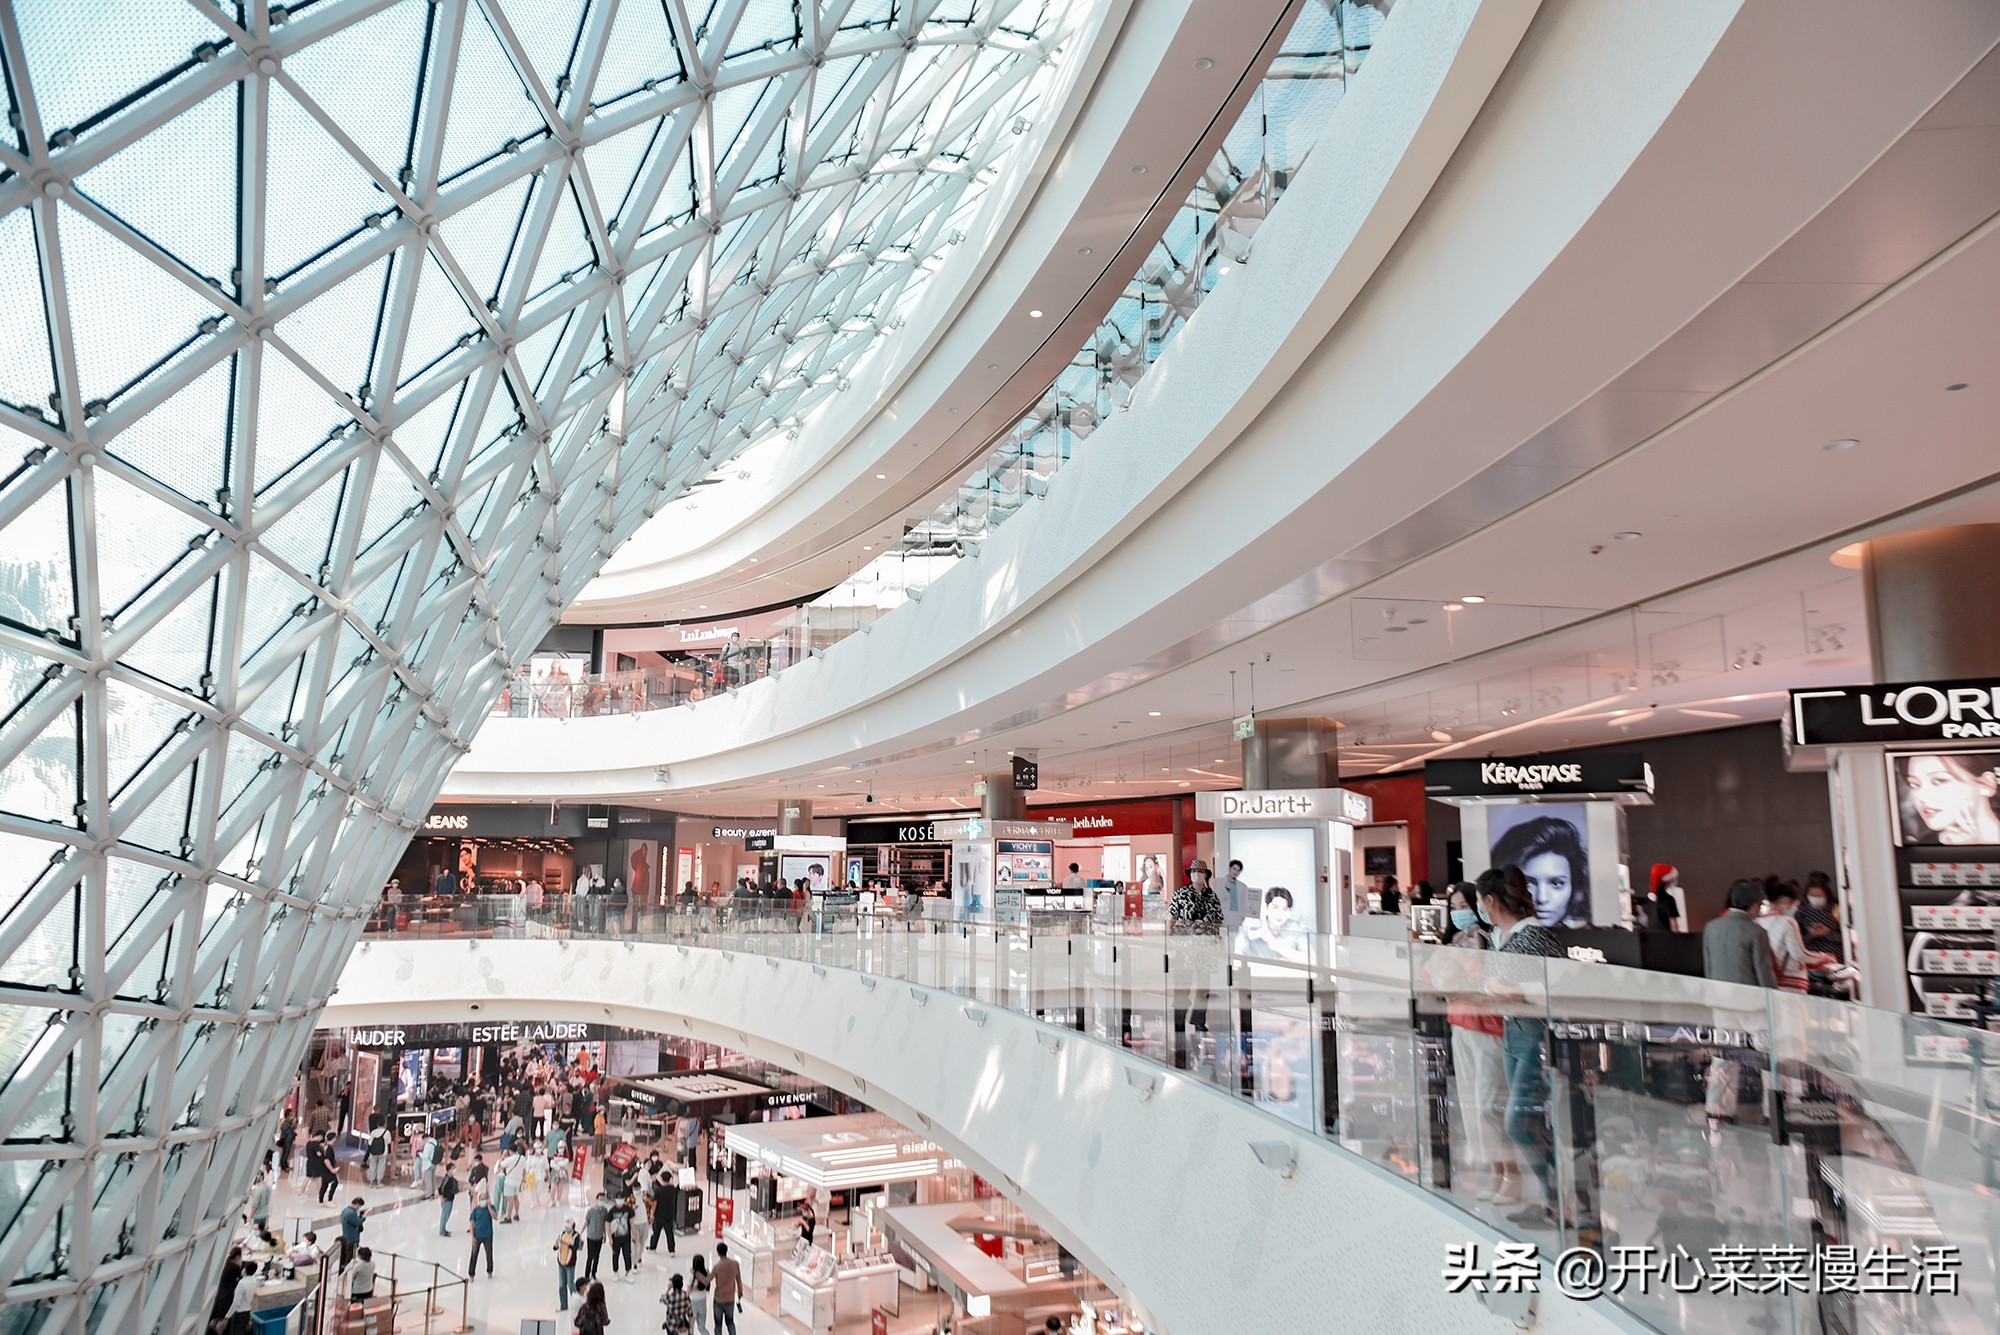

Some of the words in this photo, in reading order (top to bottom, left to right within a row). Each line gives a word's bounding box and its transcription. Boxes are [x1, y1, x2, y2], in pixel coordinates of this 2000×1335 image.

[1481, 762, 1582, 785] KÉRASTASE
[1223, 795, 1312, 815] Dr.Jart+
[425, 815, 468, 829] JEANS
[899, 822, 934, 841] KOSÉ
[1011, 842, 1033, 851] VICHY
